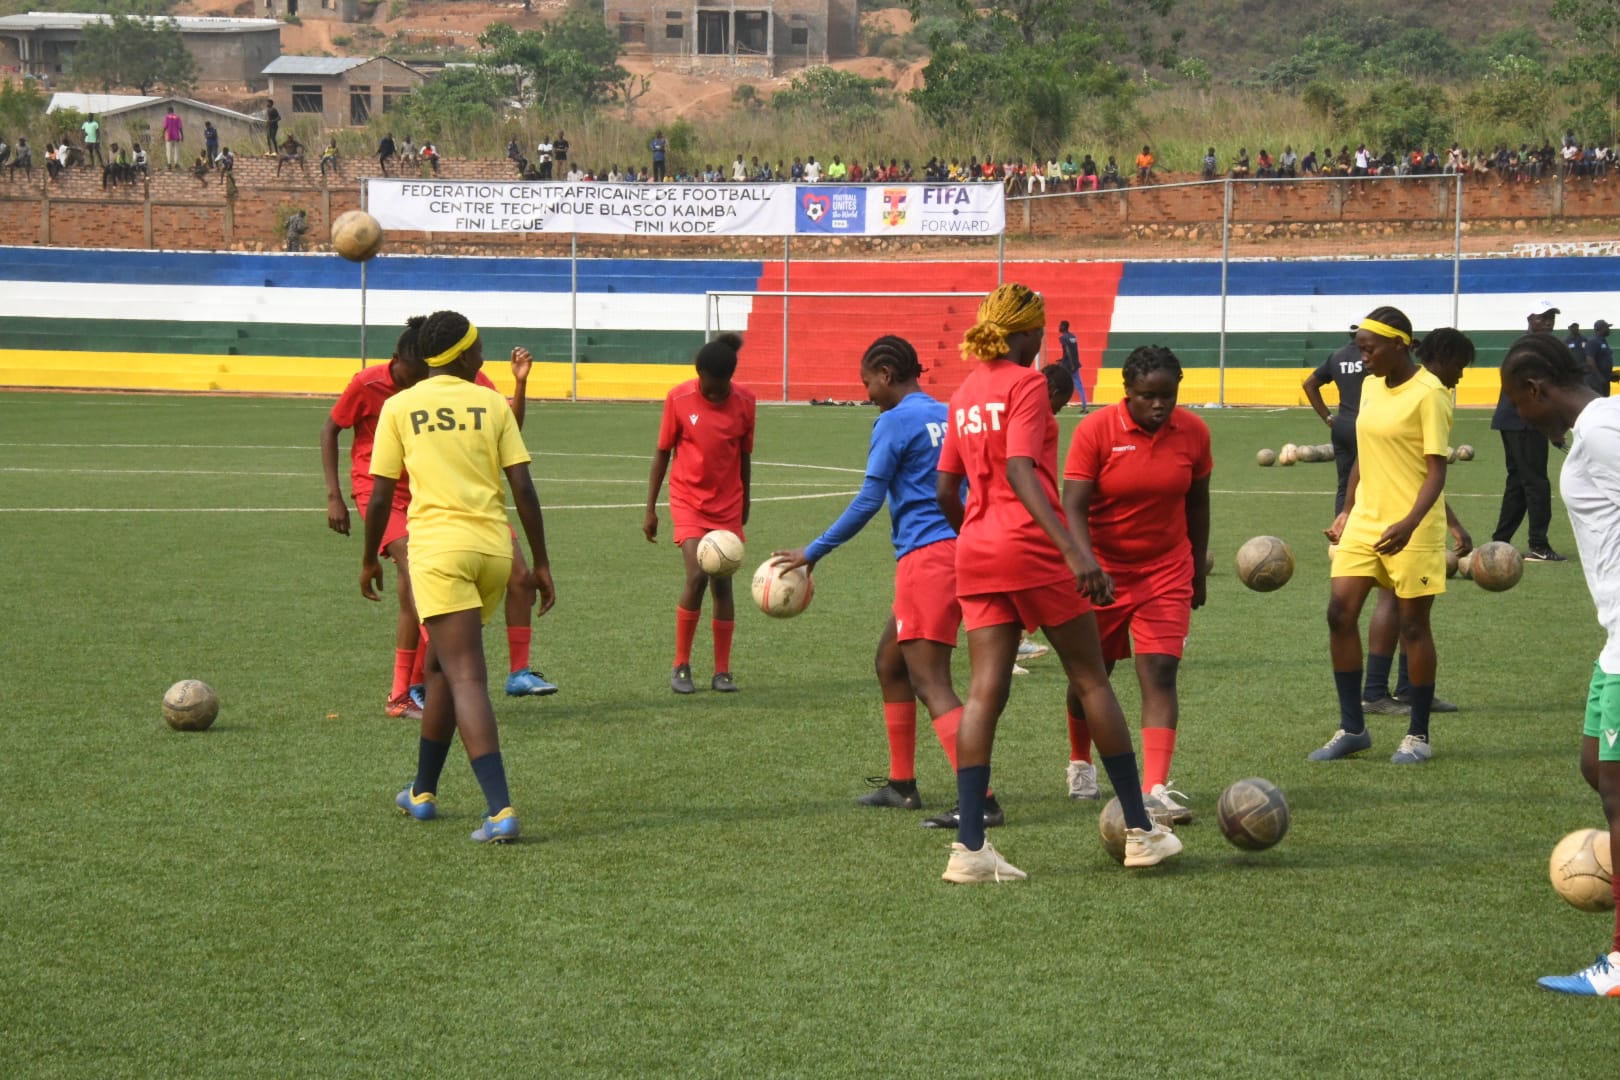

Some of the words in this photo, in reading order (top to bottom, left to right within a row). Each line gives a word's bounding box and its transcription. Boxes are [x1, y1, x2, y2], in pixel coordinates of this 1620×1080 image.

[401, 184, 504, 198] FEDERATION
[509, 186, 650, 200] CENTRAFRICAINE
[655, 188, 677, 200] DE
[682, 188, 771, 201] FOOTBALL
[923, 187, 970, 204] FIFA
[429, 201, 494, 214] CENTRE
[501, 202, 594, 215] TECHNIQUE
[600, 203, 667, 216] BLASCO
[673, 205, 737, 217] KAIMBA
[832, 201, 857, 210] UNITES
[456, 218, 485, 230] FINI
[491, 218, 544, 230] LEGUE
[634, 220, 664, 233] FINI
[670, 221, 716, 233] KODE
[921, 219, 990, 232] FORWARD
[1339, 360, 1363, 374] TDS
[410, 407, 487, 436] P.S.T
[955, 402, 1006, 438] P.S.T
